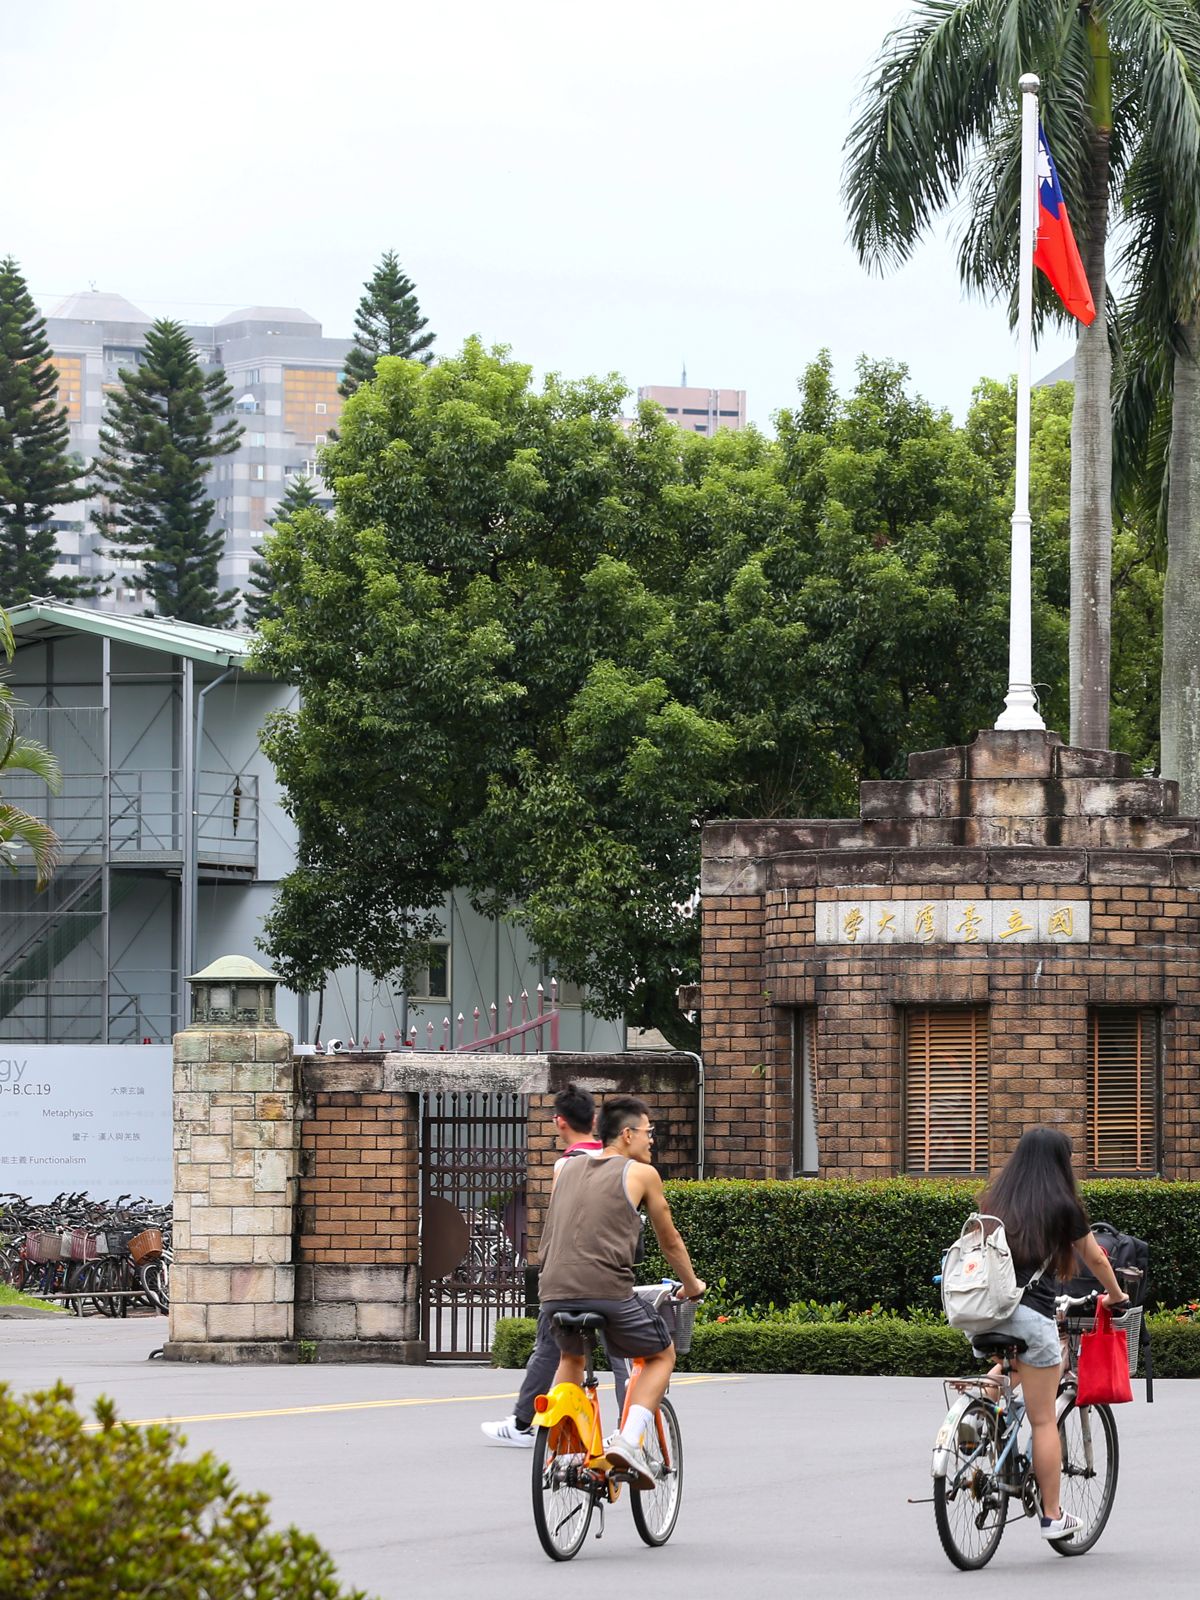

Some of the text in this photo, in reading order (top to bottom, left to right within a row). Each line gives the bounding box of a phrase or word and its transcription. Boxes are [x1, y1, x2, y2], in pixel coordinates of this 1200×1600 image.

[843, 902, 1074, 942] 國立臺灣大學
[42, 1109, 94, 1119] Metaphysics
[29, 1156, 87, 1165] Functionalism
